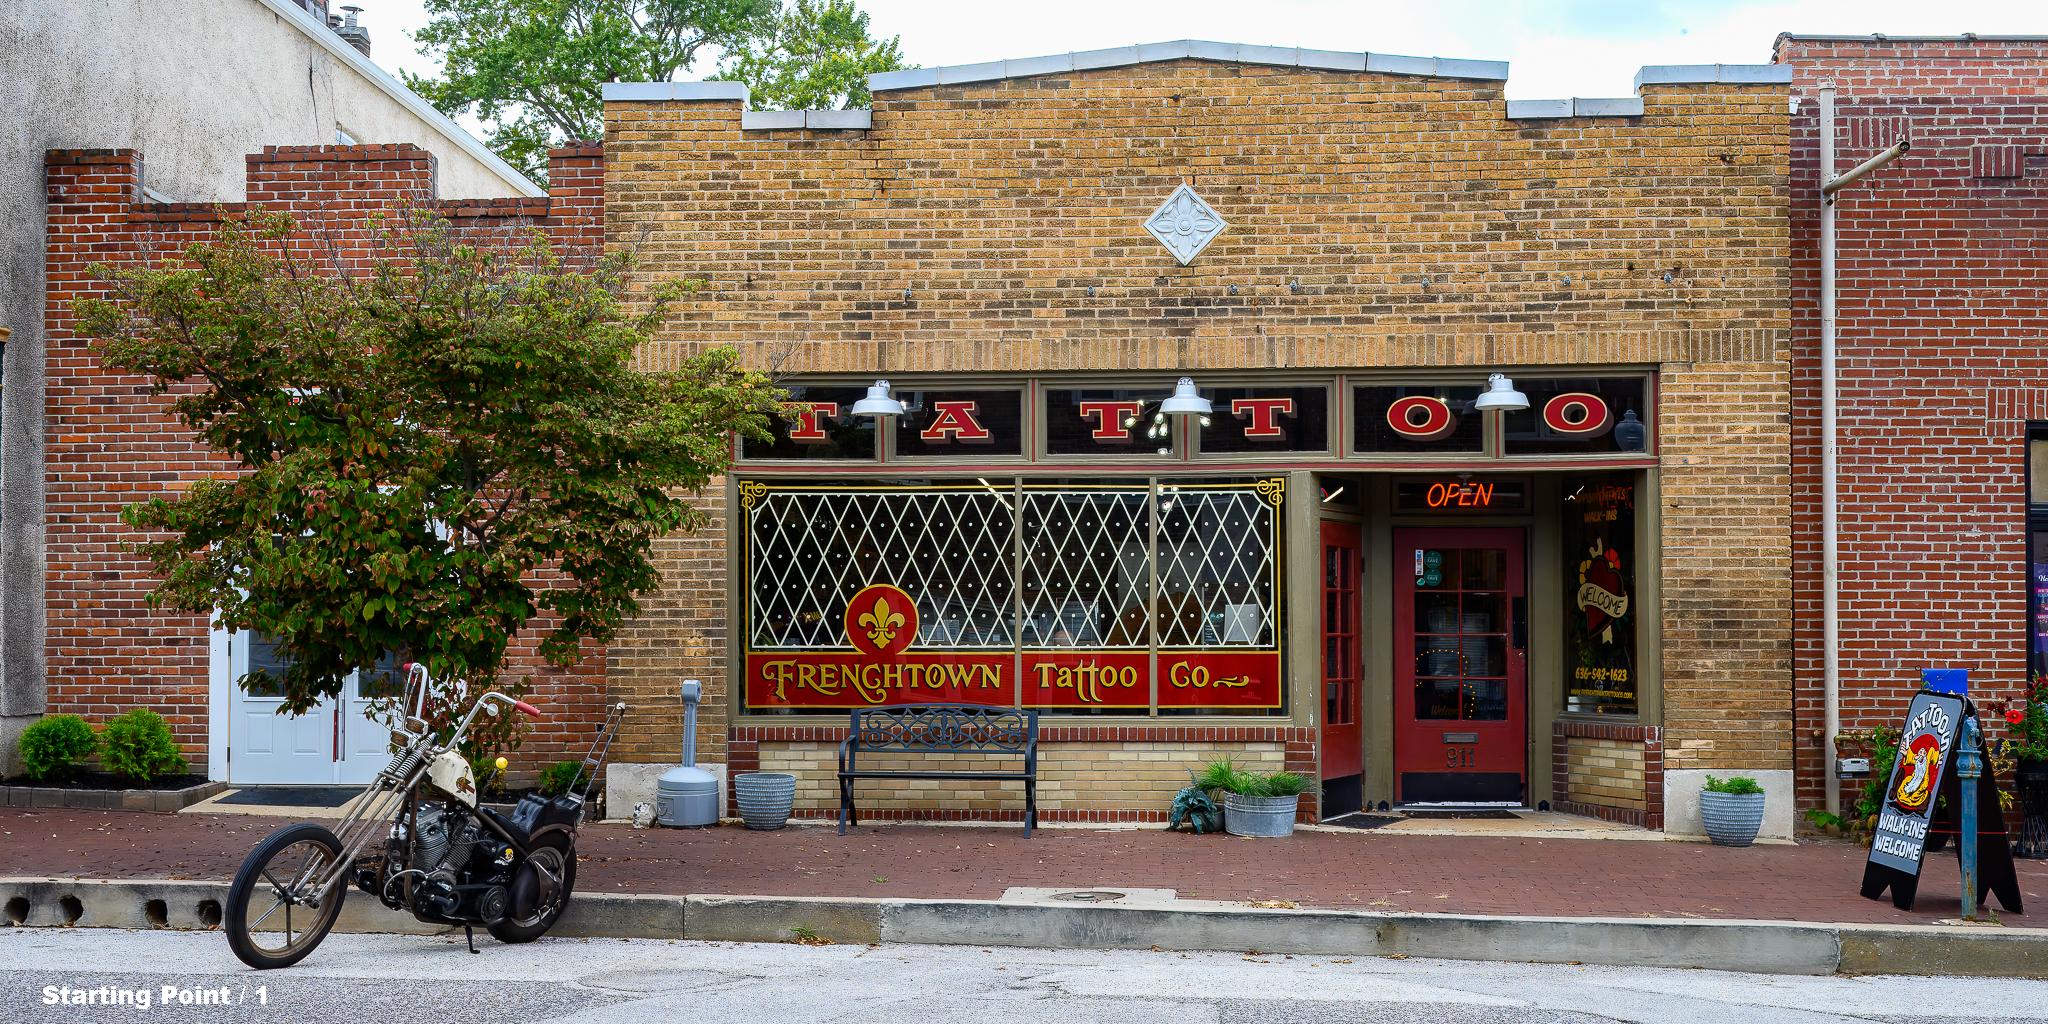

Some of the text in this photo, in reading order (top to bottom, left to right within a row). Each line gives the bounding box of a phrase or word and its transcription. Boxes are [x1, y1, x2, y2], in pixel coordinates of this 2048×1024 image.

[779, 393, 1609, 441] TATTOO
[1427, 483, 1494, 507] OPEN
[1580, 586, 1625, 616] WELCOME
[1033, 659, 1138, 702] Tattoo
[1170, 660, 1210, 688] Co
[1575, 666, 1627, 682] 636-542-1623
[1903, 702, 1951, 753] TATTOOS
[1447, 747, 1475, 769] 911
[1879, 812, 1928, 840] WALK-INS
[1875, 835, 1922, 862] WELCOME
